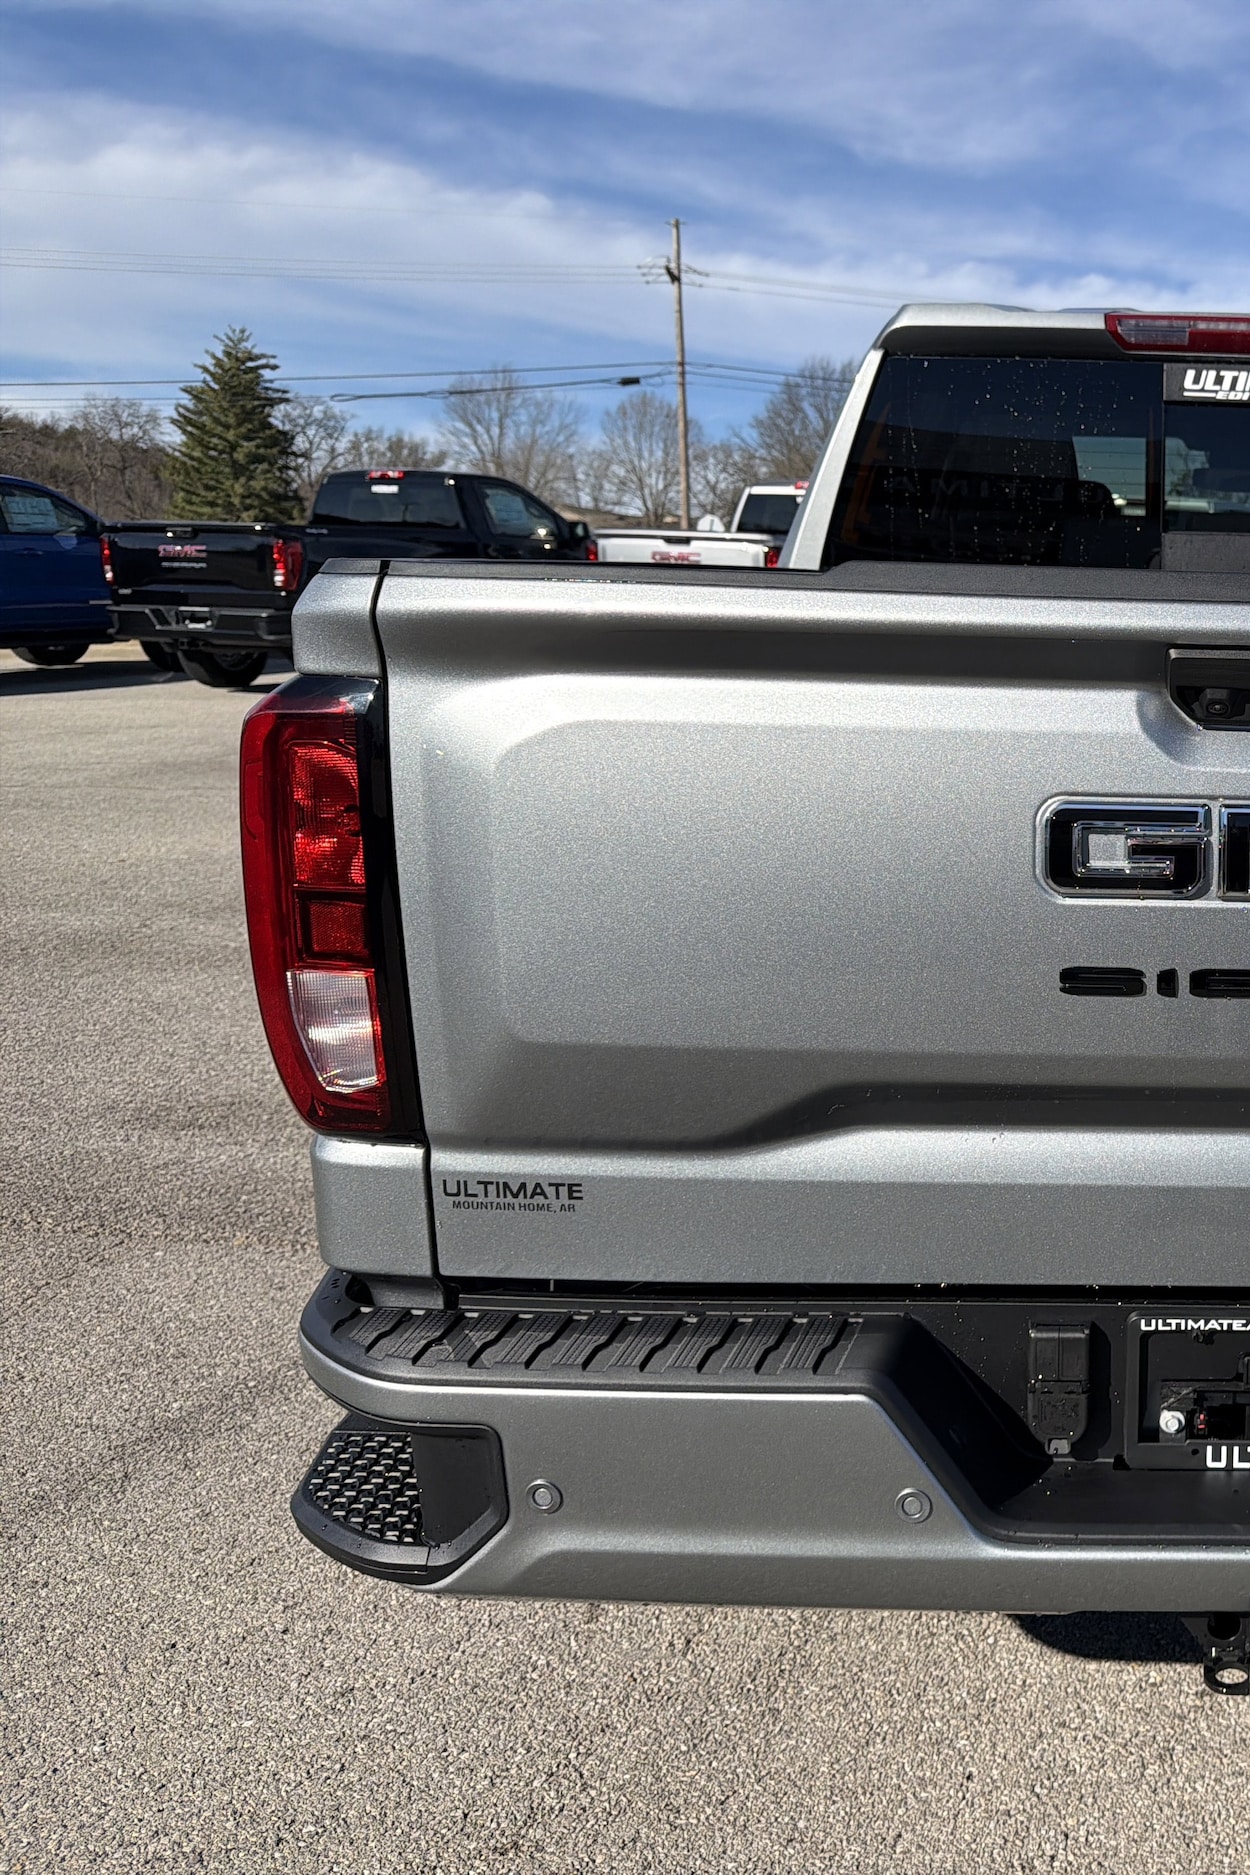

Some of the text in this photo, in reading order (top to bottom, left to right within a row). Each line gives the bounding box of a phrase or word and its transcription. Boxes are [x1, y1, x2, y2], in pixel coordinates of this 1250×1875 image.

[442, 1179, 584, 1201] ULTIMATE
[452, 1200, 577, 1214] MOUNTAIN HOME, AR
